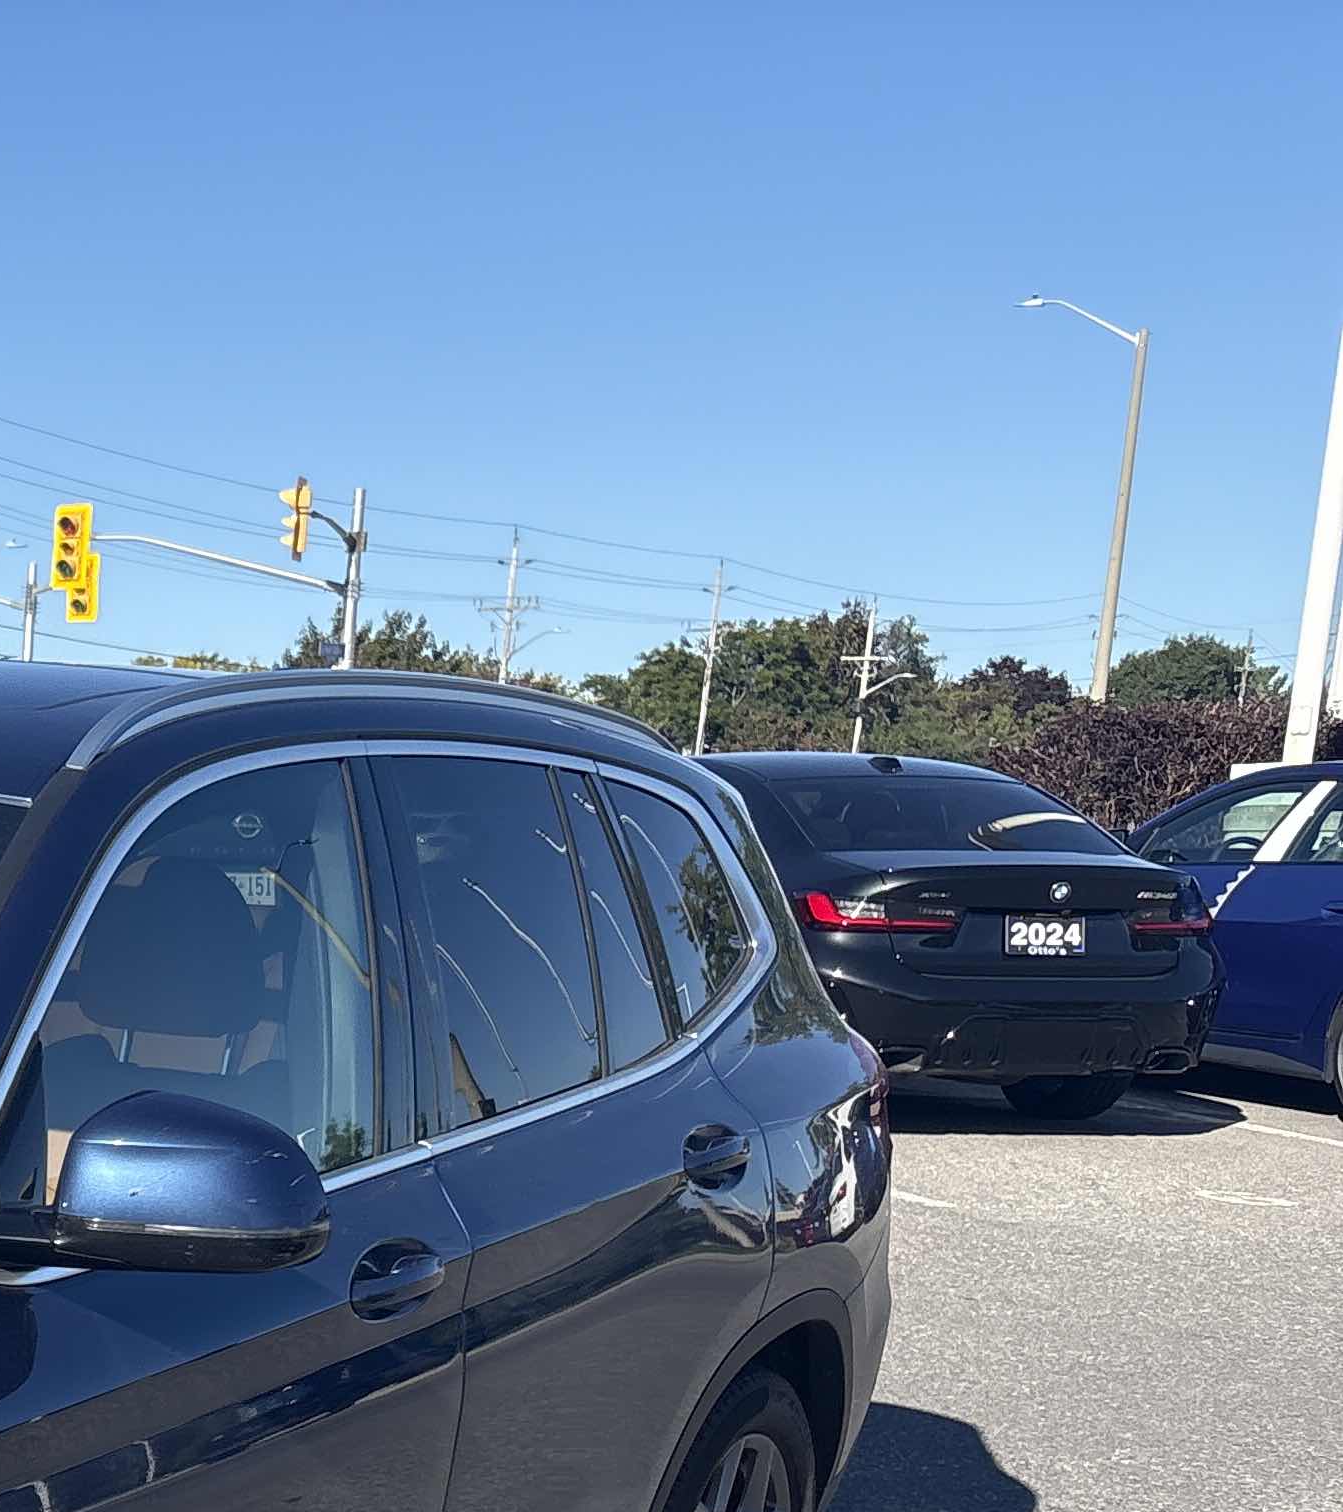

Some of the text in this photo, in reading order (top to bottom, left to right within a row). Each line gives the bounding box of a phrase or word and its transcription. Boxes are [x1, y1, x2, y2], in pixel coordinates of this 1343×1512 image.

[247, 876, 272, 897] 151
[1010, 921, 1082, 946] 2024
[1027, 945, 1068, 956] Otto's
